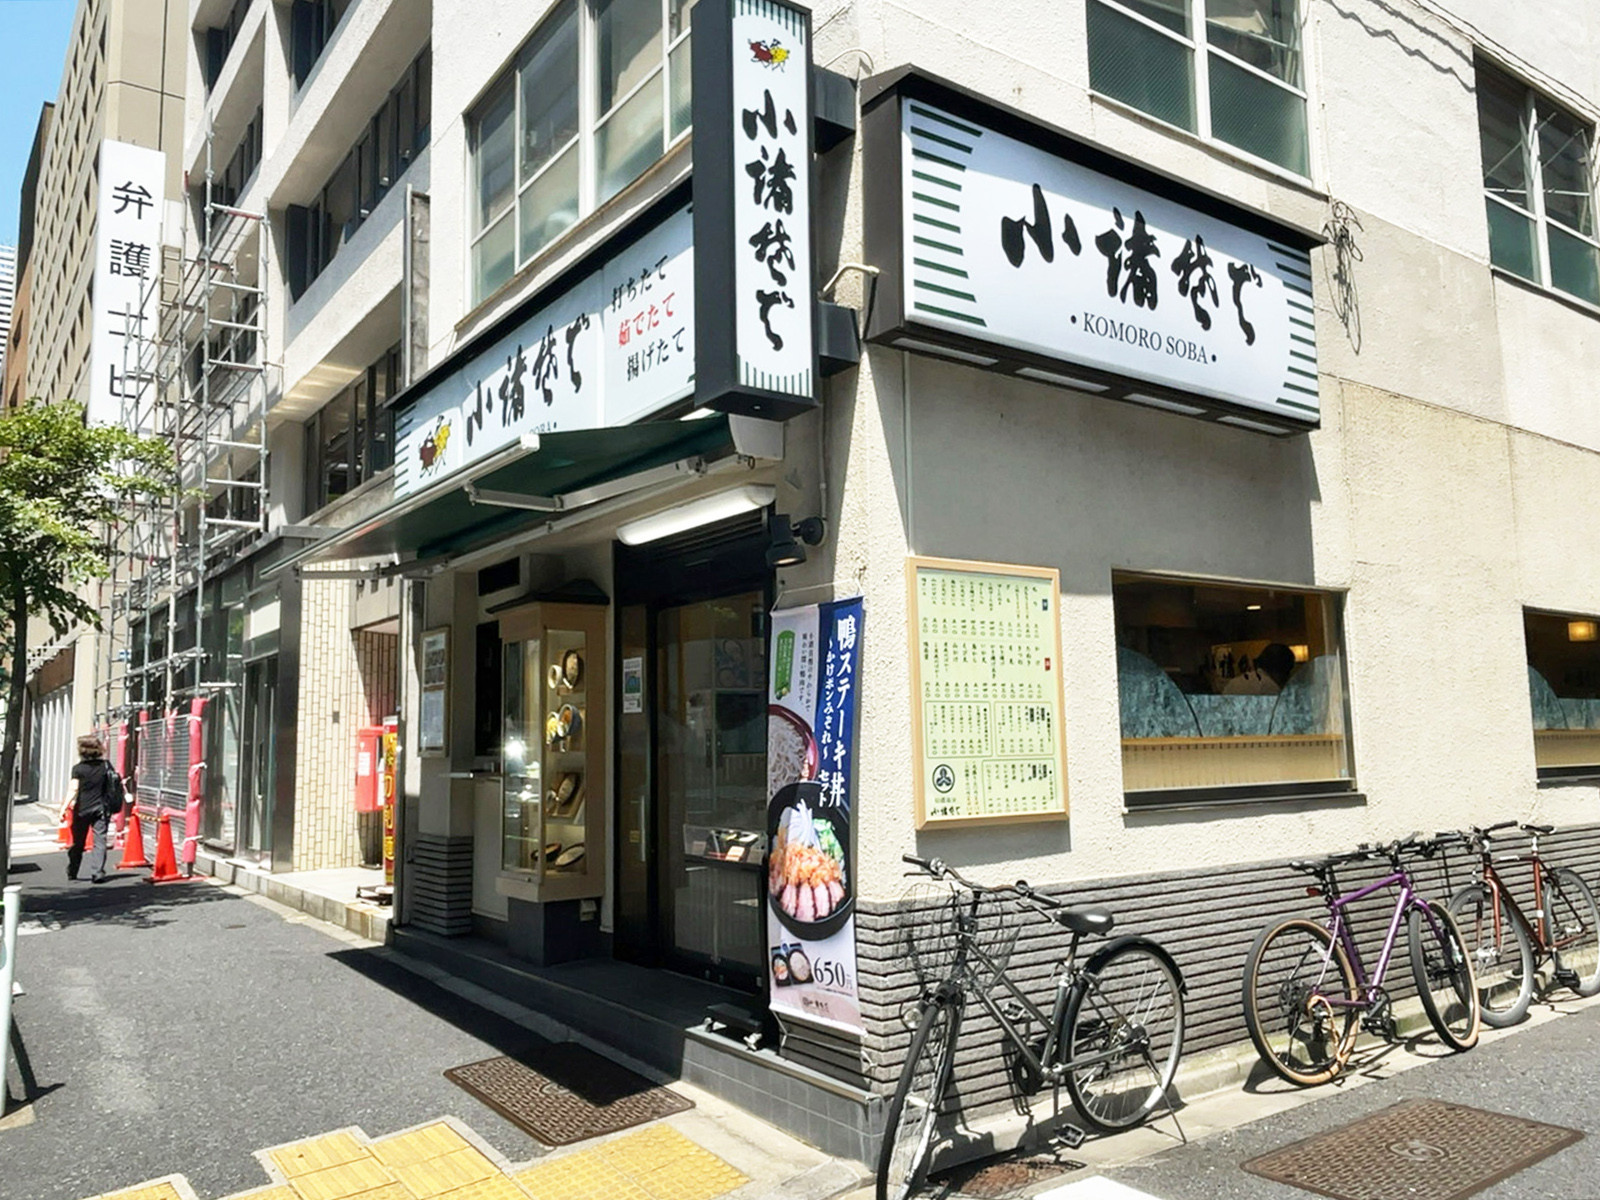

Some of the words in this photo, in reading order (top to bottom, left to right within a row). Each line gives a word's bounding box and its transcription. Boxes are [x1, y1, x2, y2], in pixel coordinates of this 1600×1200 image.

[612, 255, 668, 313] 打ちたて
[618, 292, 675, 346] 茹でたて
[1083, 311, 1162, 352] KOMORO
[1166, 339, 1208, 365] SOBA
[627, 326, 685, 382] 揚げたて
[829, 614, 857, 808] 鴨ステーキ丼
[818, 769, 832, 808] セット
